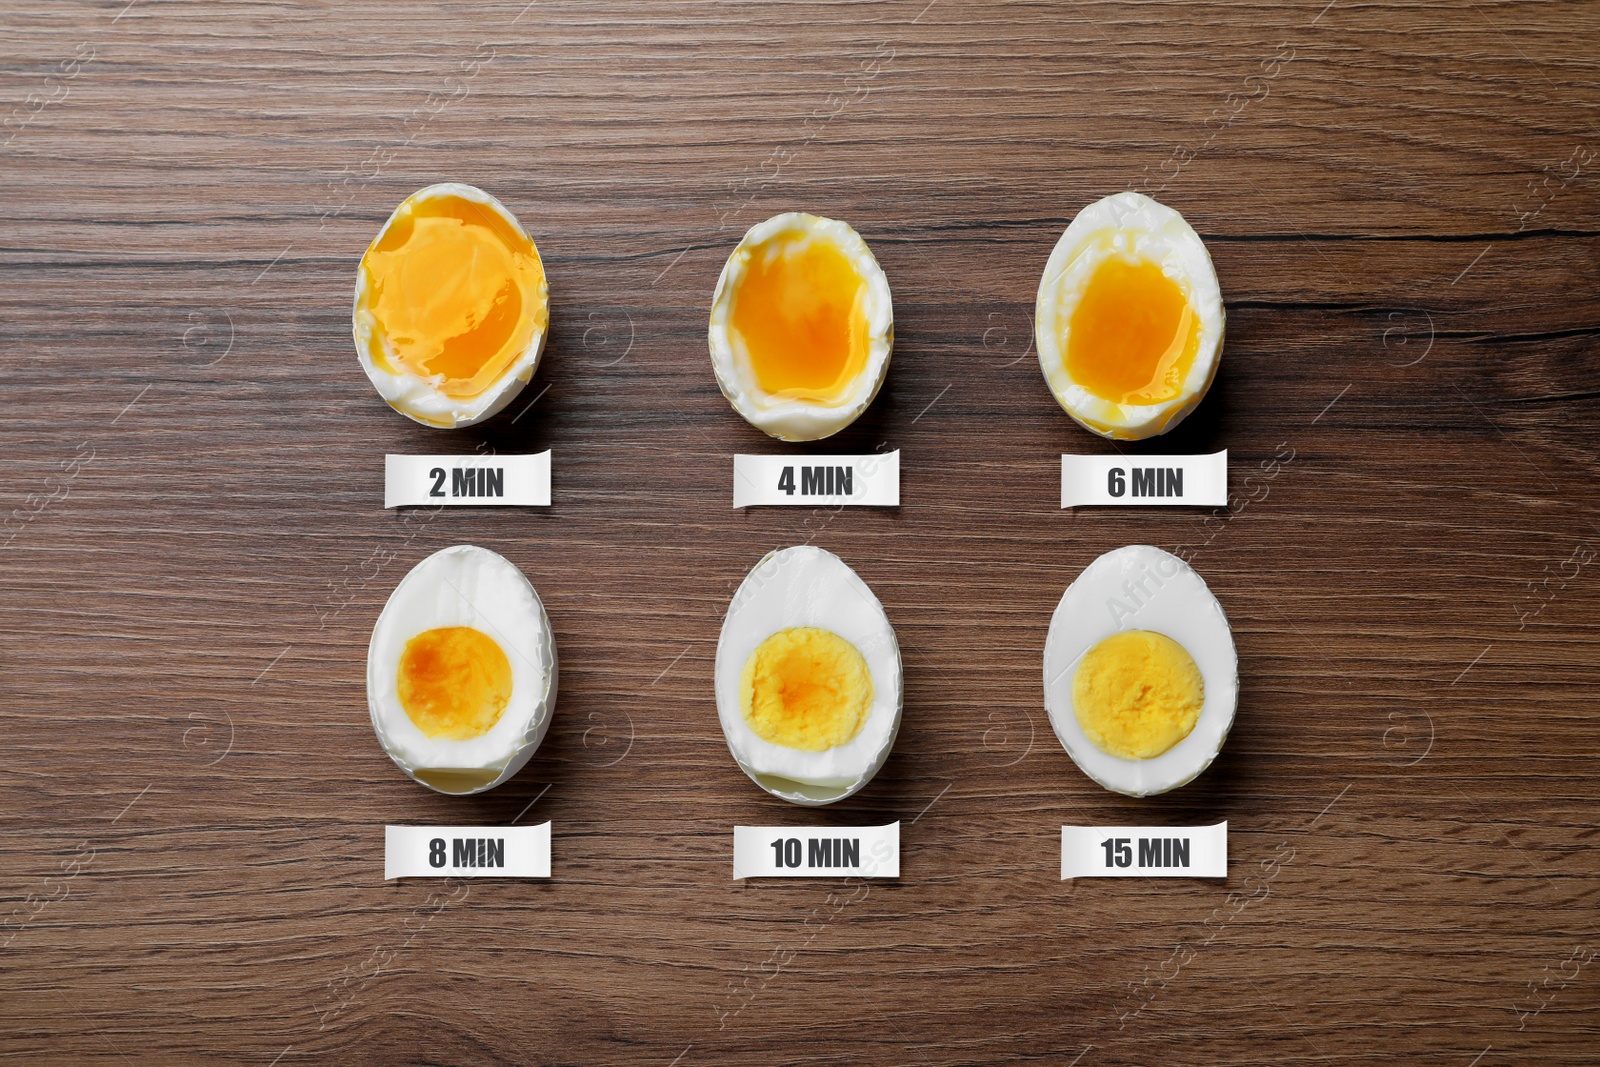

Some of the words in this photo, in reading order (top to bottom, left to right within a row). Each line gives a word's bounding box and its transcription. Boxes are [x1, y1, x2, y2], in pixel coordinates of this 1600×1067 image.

[429, 467, 447, 497] 2
[452, 467, 504, 497] MIN
[777, 466, 796, 496] 4
[801, 466, 853, 496] MIN
[1107, 467, 1126, 498] 6
[1131, 467, 1184, 497] MIN
[429, 838, 447, 868] 8
[452, 838, 505, 868] MIN
[770, 838, 802, 868] 10
[808, 838, 860, 868] MIN
[1100, 838, 1133, 868] 15
[1138, 838, 1190, 868] MIN
